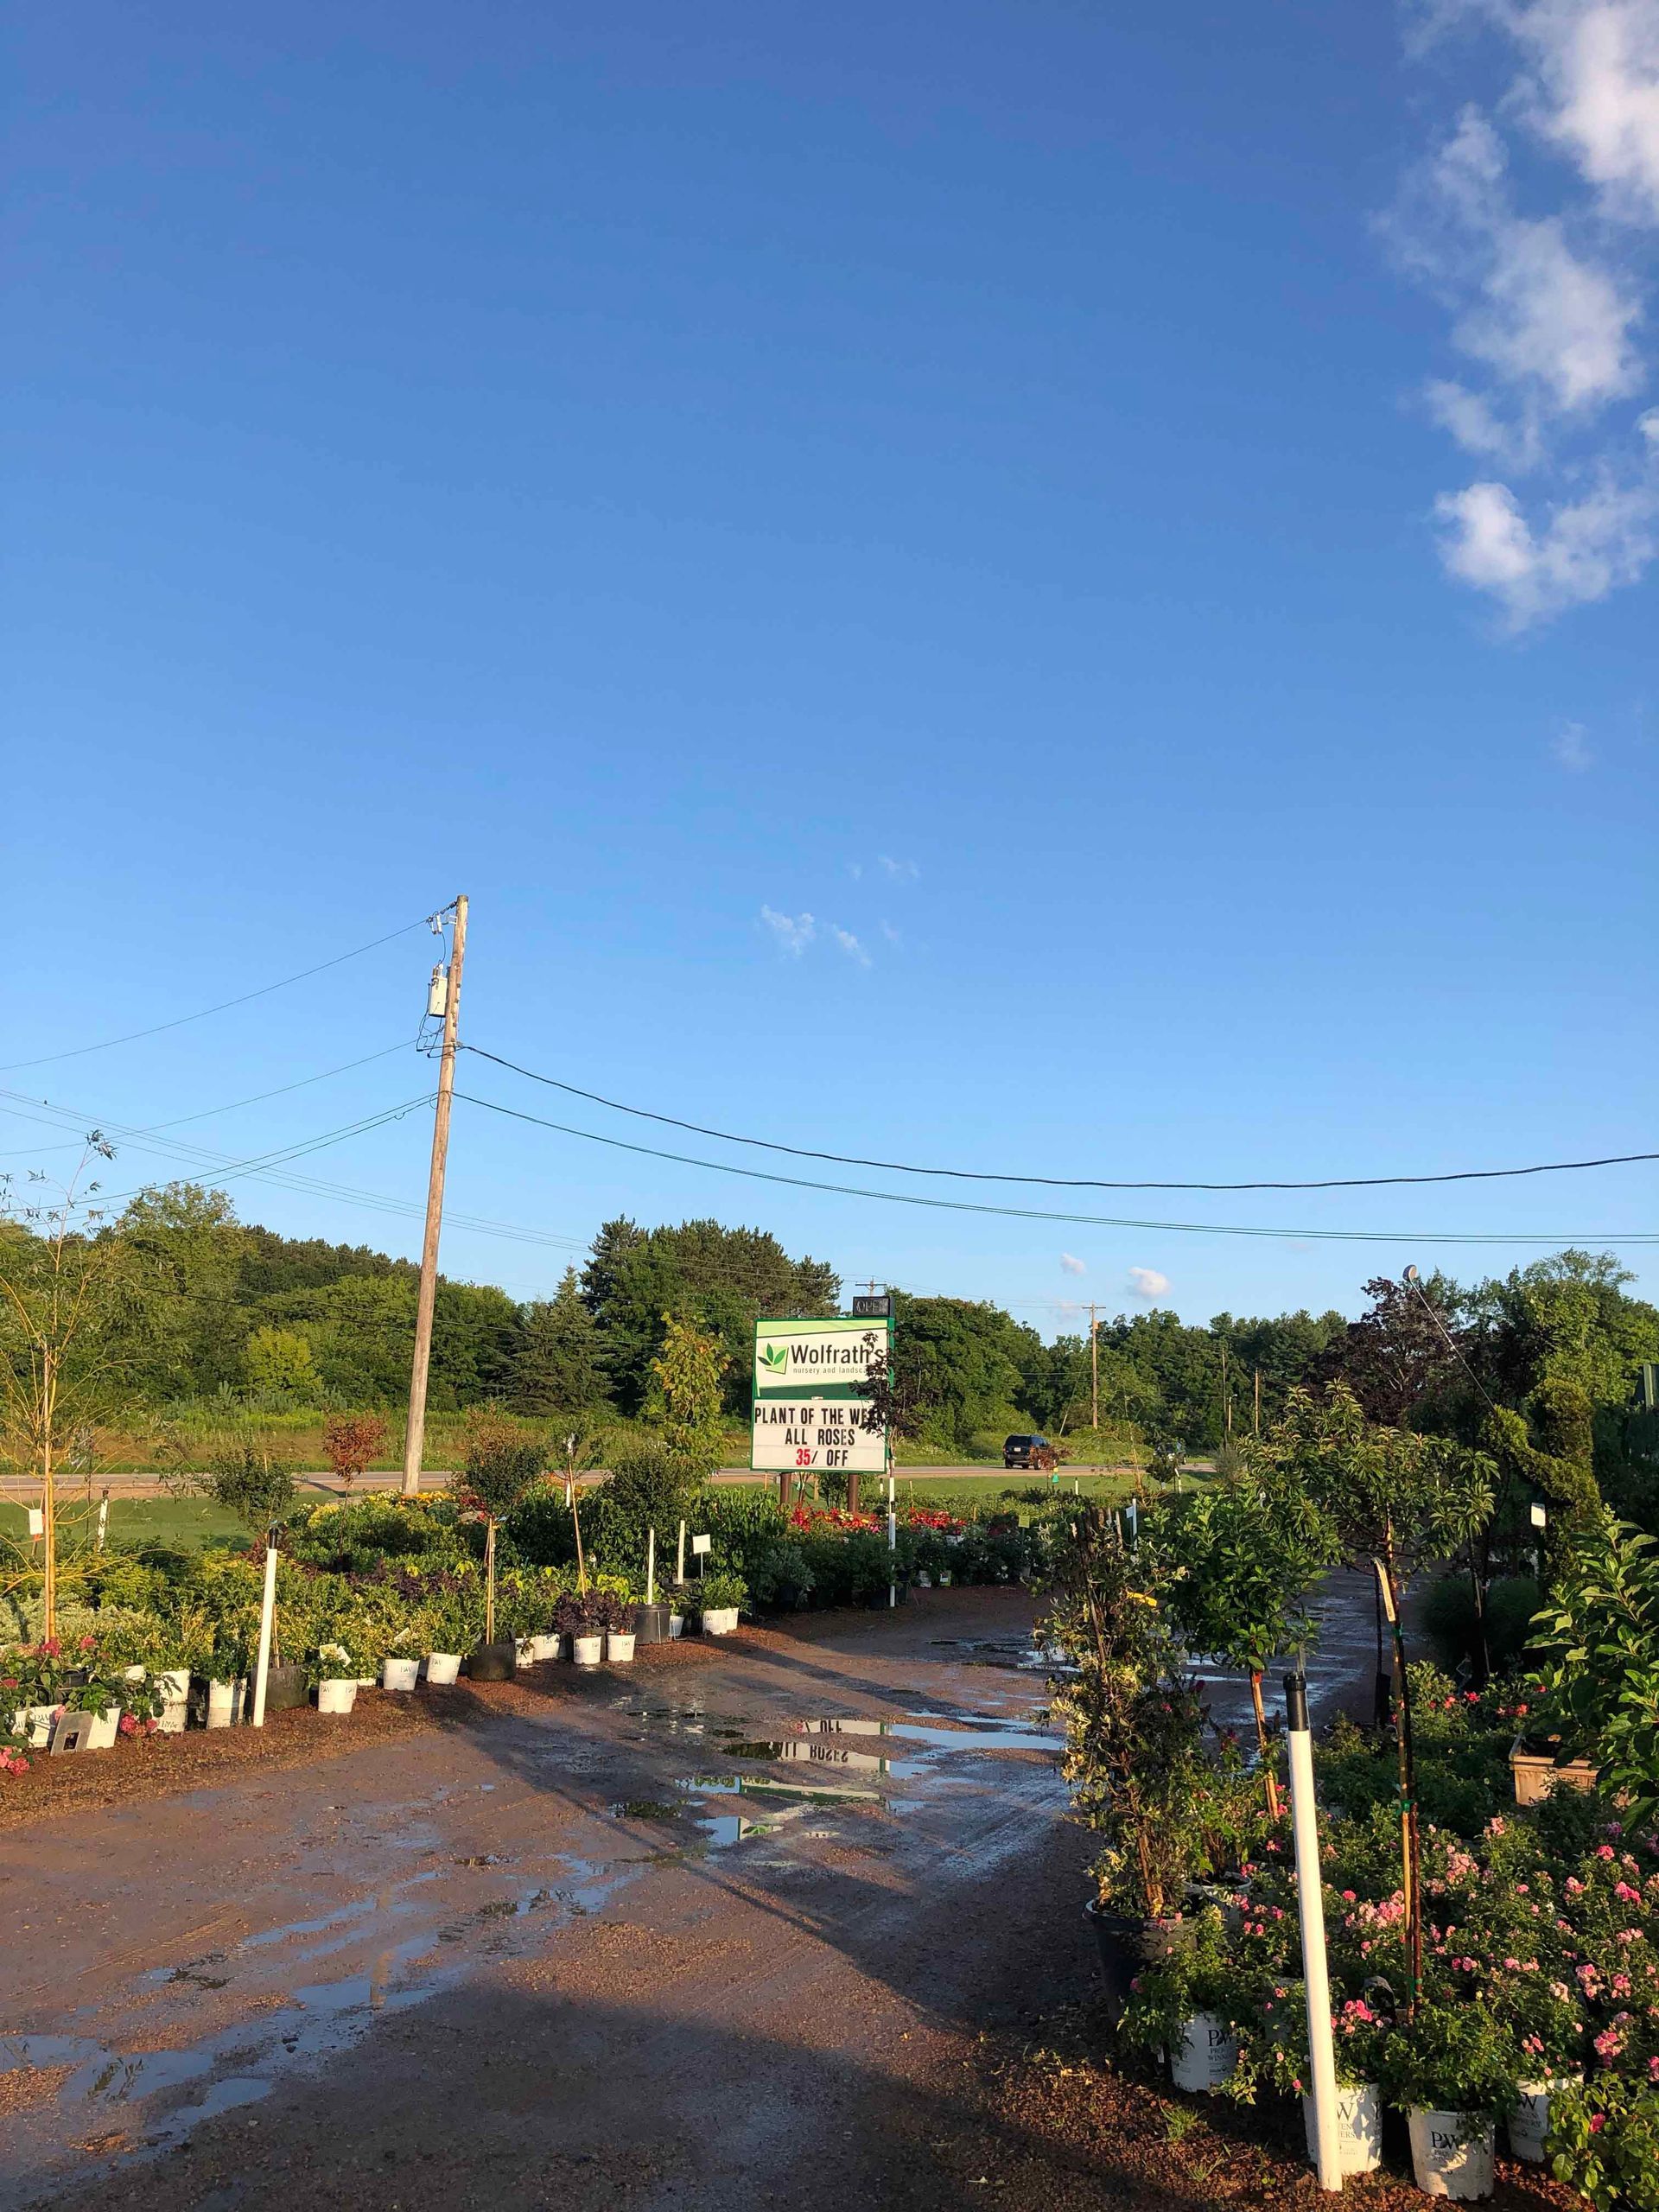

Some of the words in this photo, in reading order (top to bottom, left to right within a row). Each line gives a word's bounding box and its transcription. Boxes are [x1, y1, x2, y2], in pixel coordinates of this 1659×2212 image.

[856, 1300, 887, 1313] OPEN
[754, 1408, 795, 1424] PLANT
[800, 1408, 814, 1424] OF
[822, 1408, 843, 1424] THE
[785, 1428, 807, 1445] ALL
[818, 1428, 855, 1446] ROSES
[826, 1449, 849, 1466] OFF
